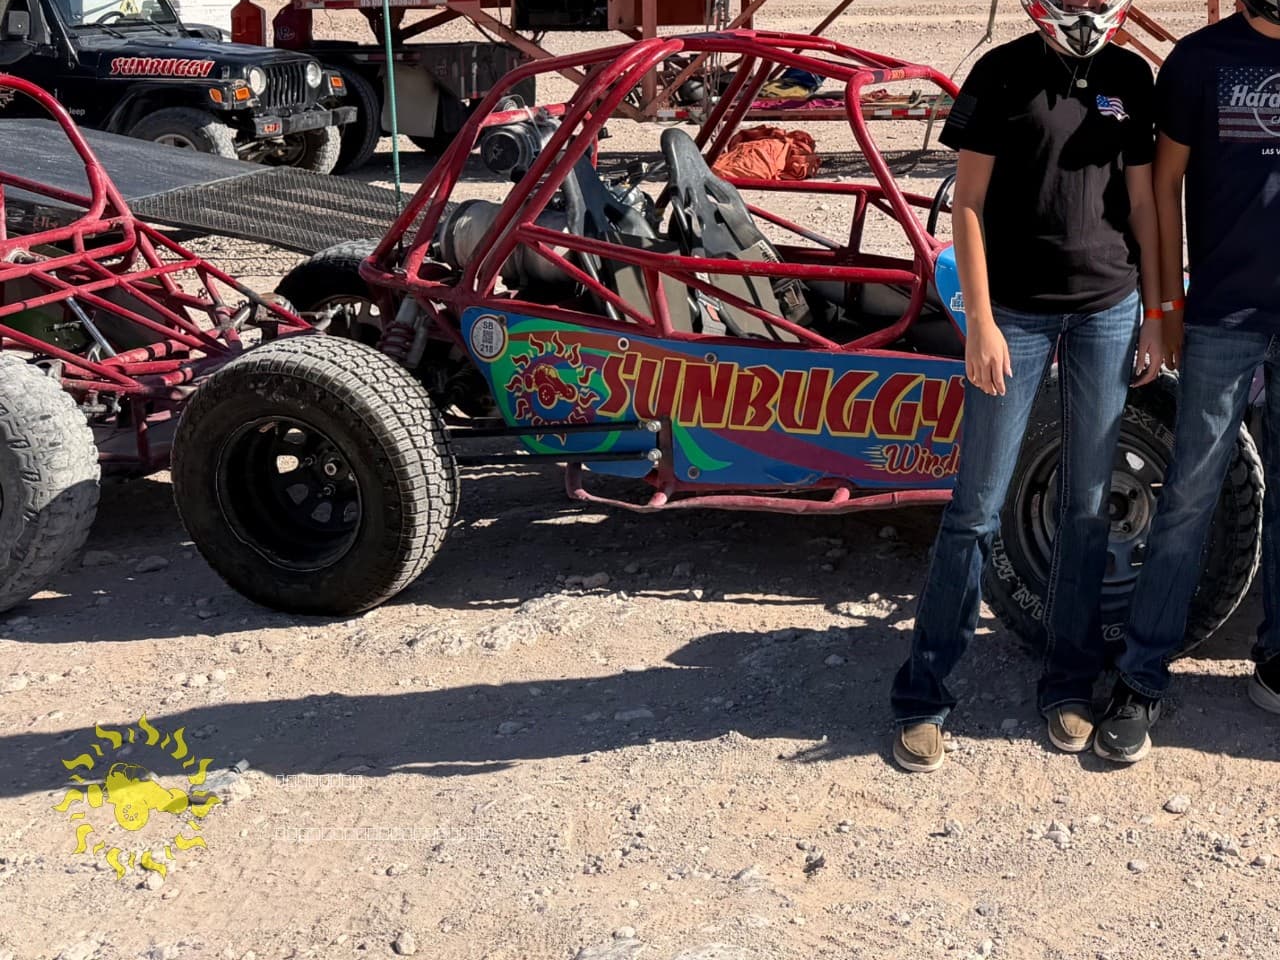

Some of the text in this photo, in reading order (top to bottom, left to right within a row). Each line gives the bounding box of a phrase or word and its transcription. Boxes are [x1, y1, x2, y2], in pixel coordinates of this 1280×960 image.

[110, 57, 216, 77] SUNBUGGY
[1261, 148, 1274, 156] LAS
[596, 350, 966, 444] SUNBUGGY
